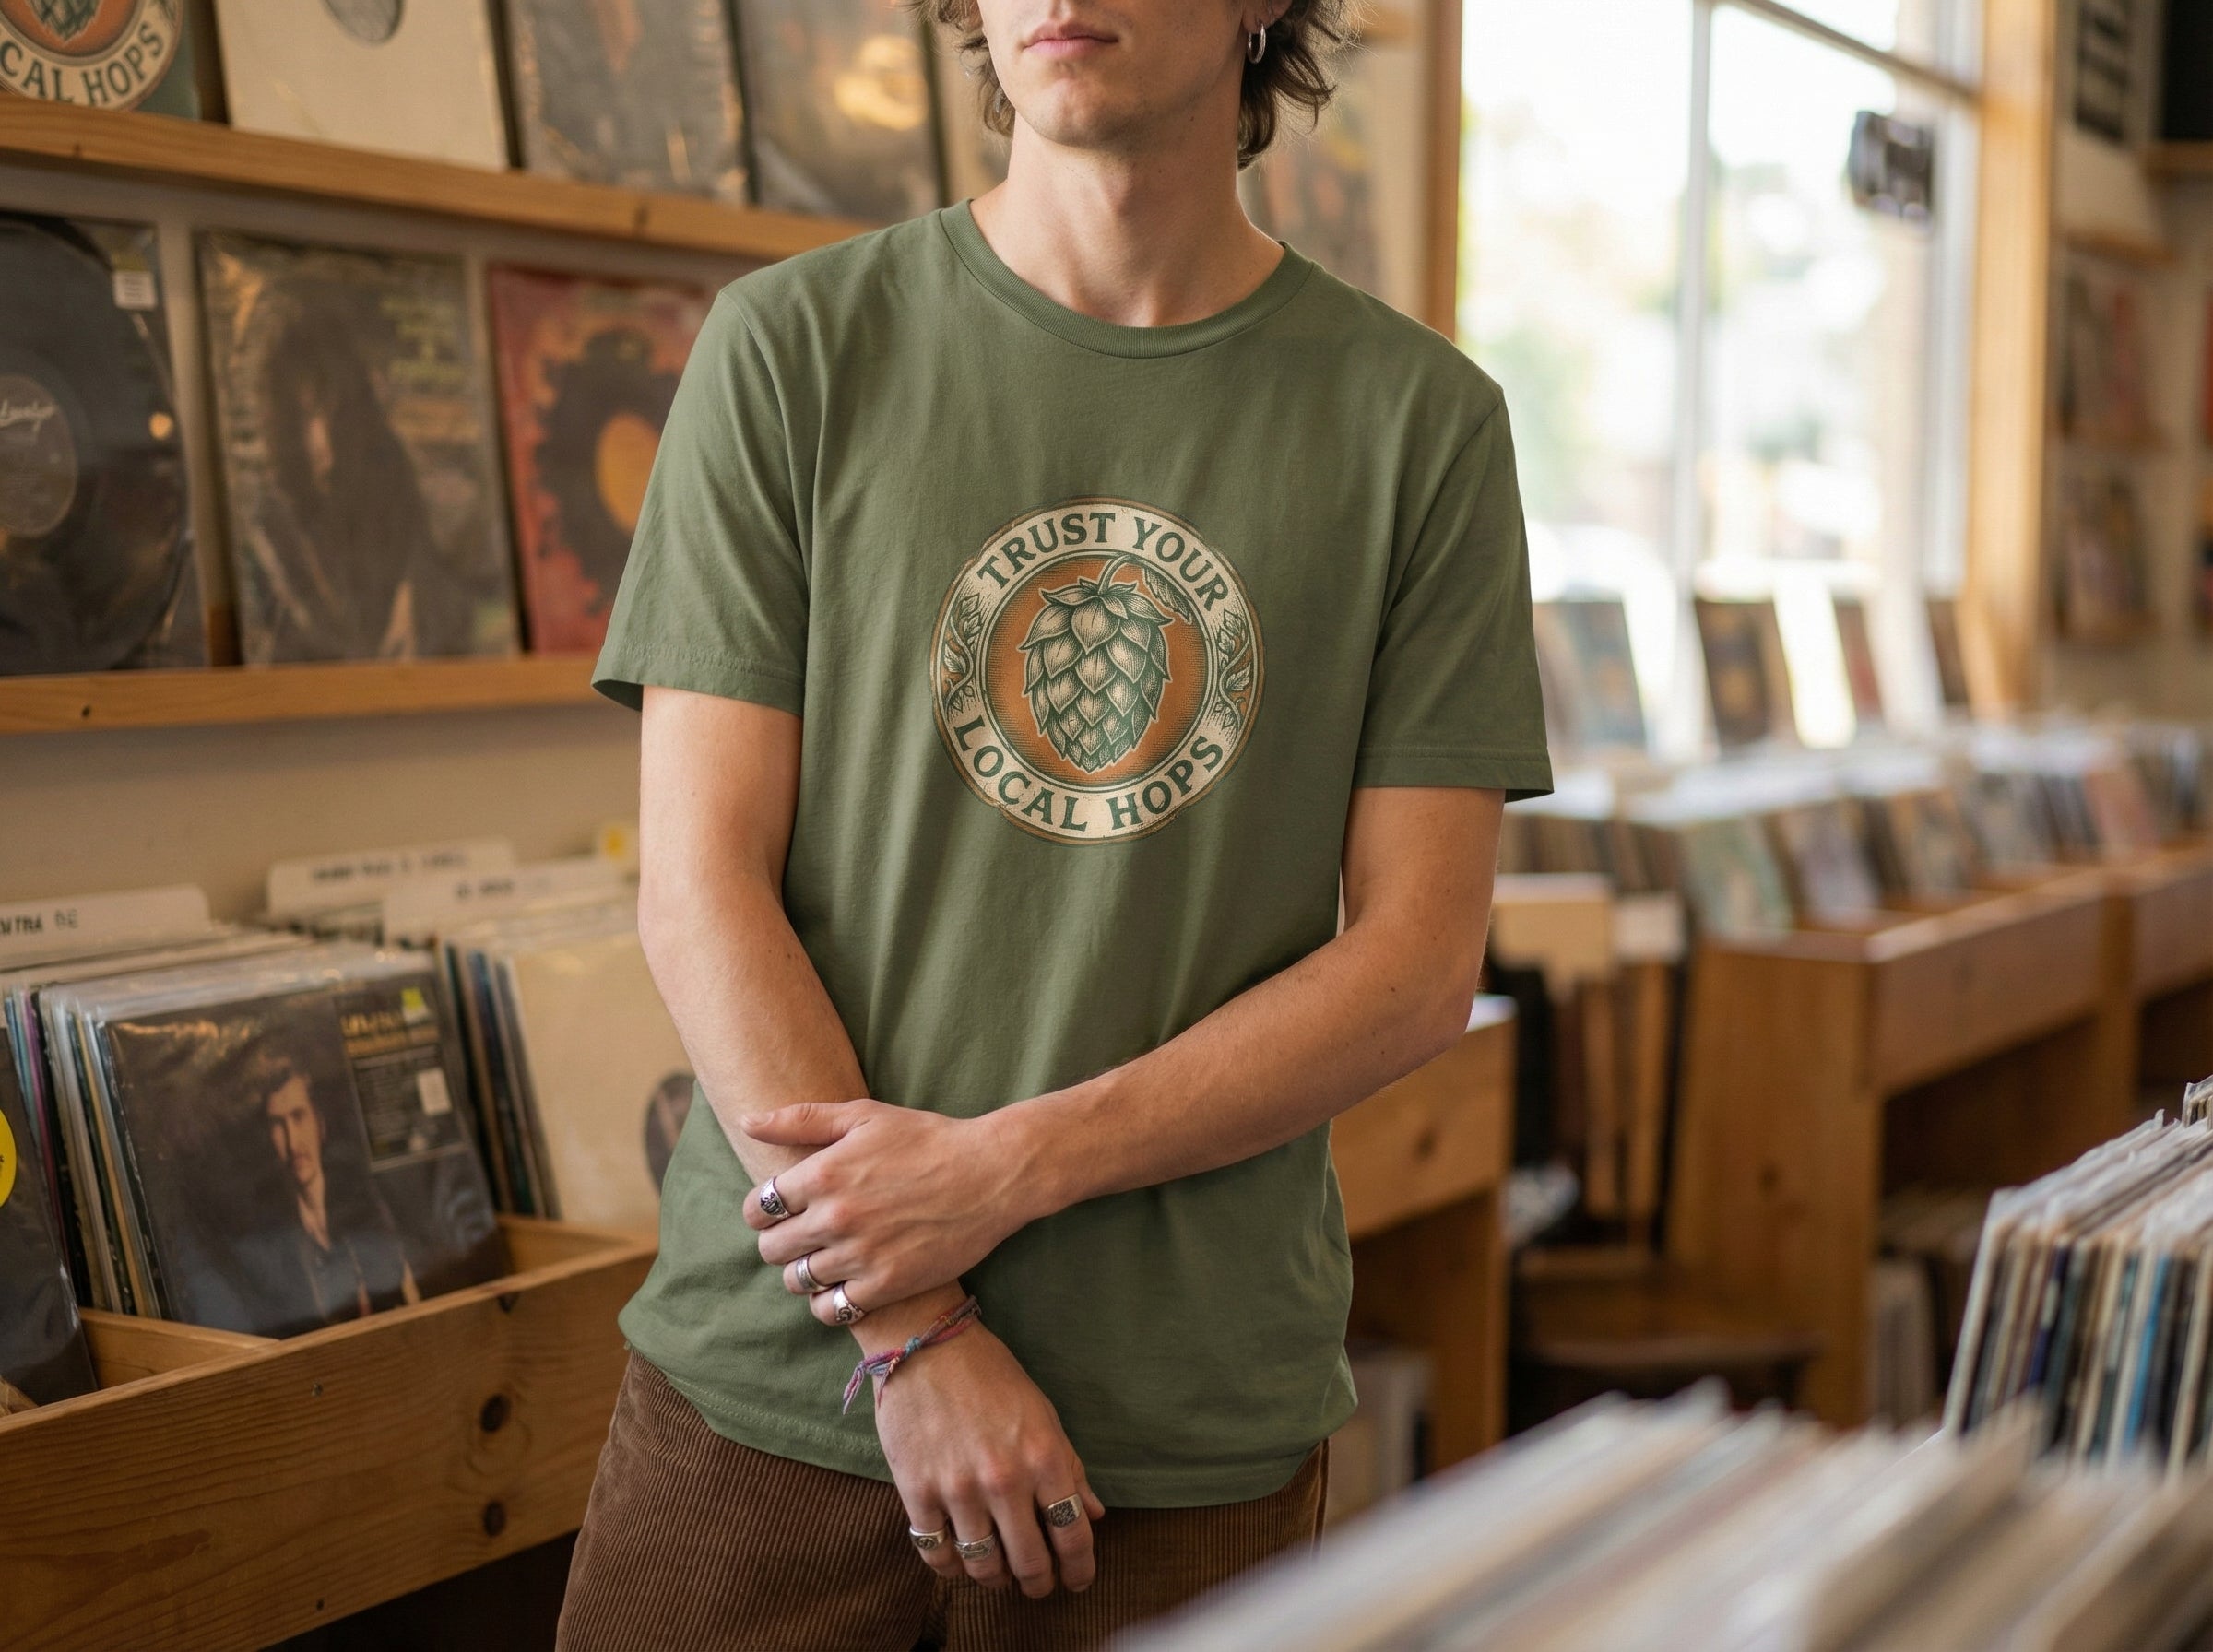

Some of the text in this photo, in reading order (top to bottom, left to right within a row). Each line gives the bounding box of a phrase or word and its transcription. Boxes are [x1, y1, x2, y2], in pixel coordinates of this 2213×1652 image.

[80, 21, 164, 105] HOPS
[976, 512, 1229, 610] TRUST YOUR
[953, 716, 1224, 832] LOCAL HOPS
